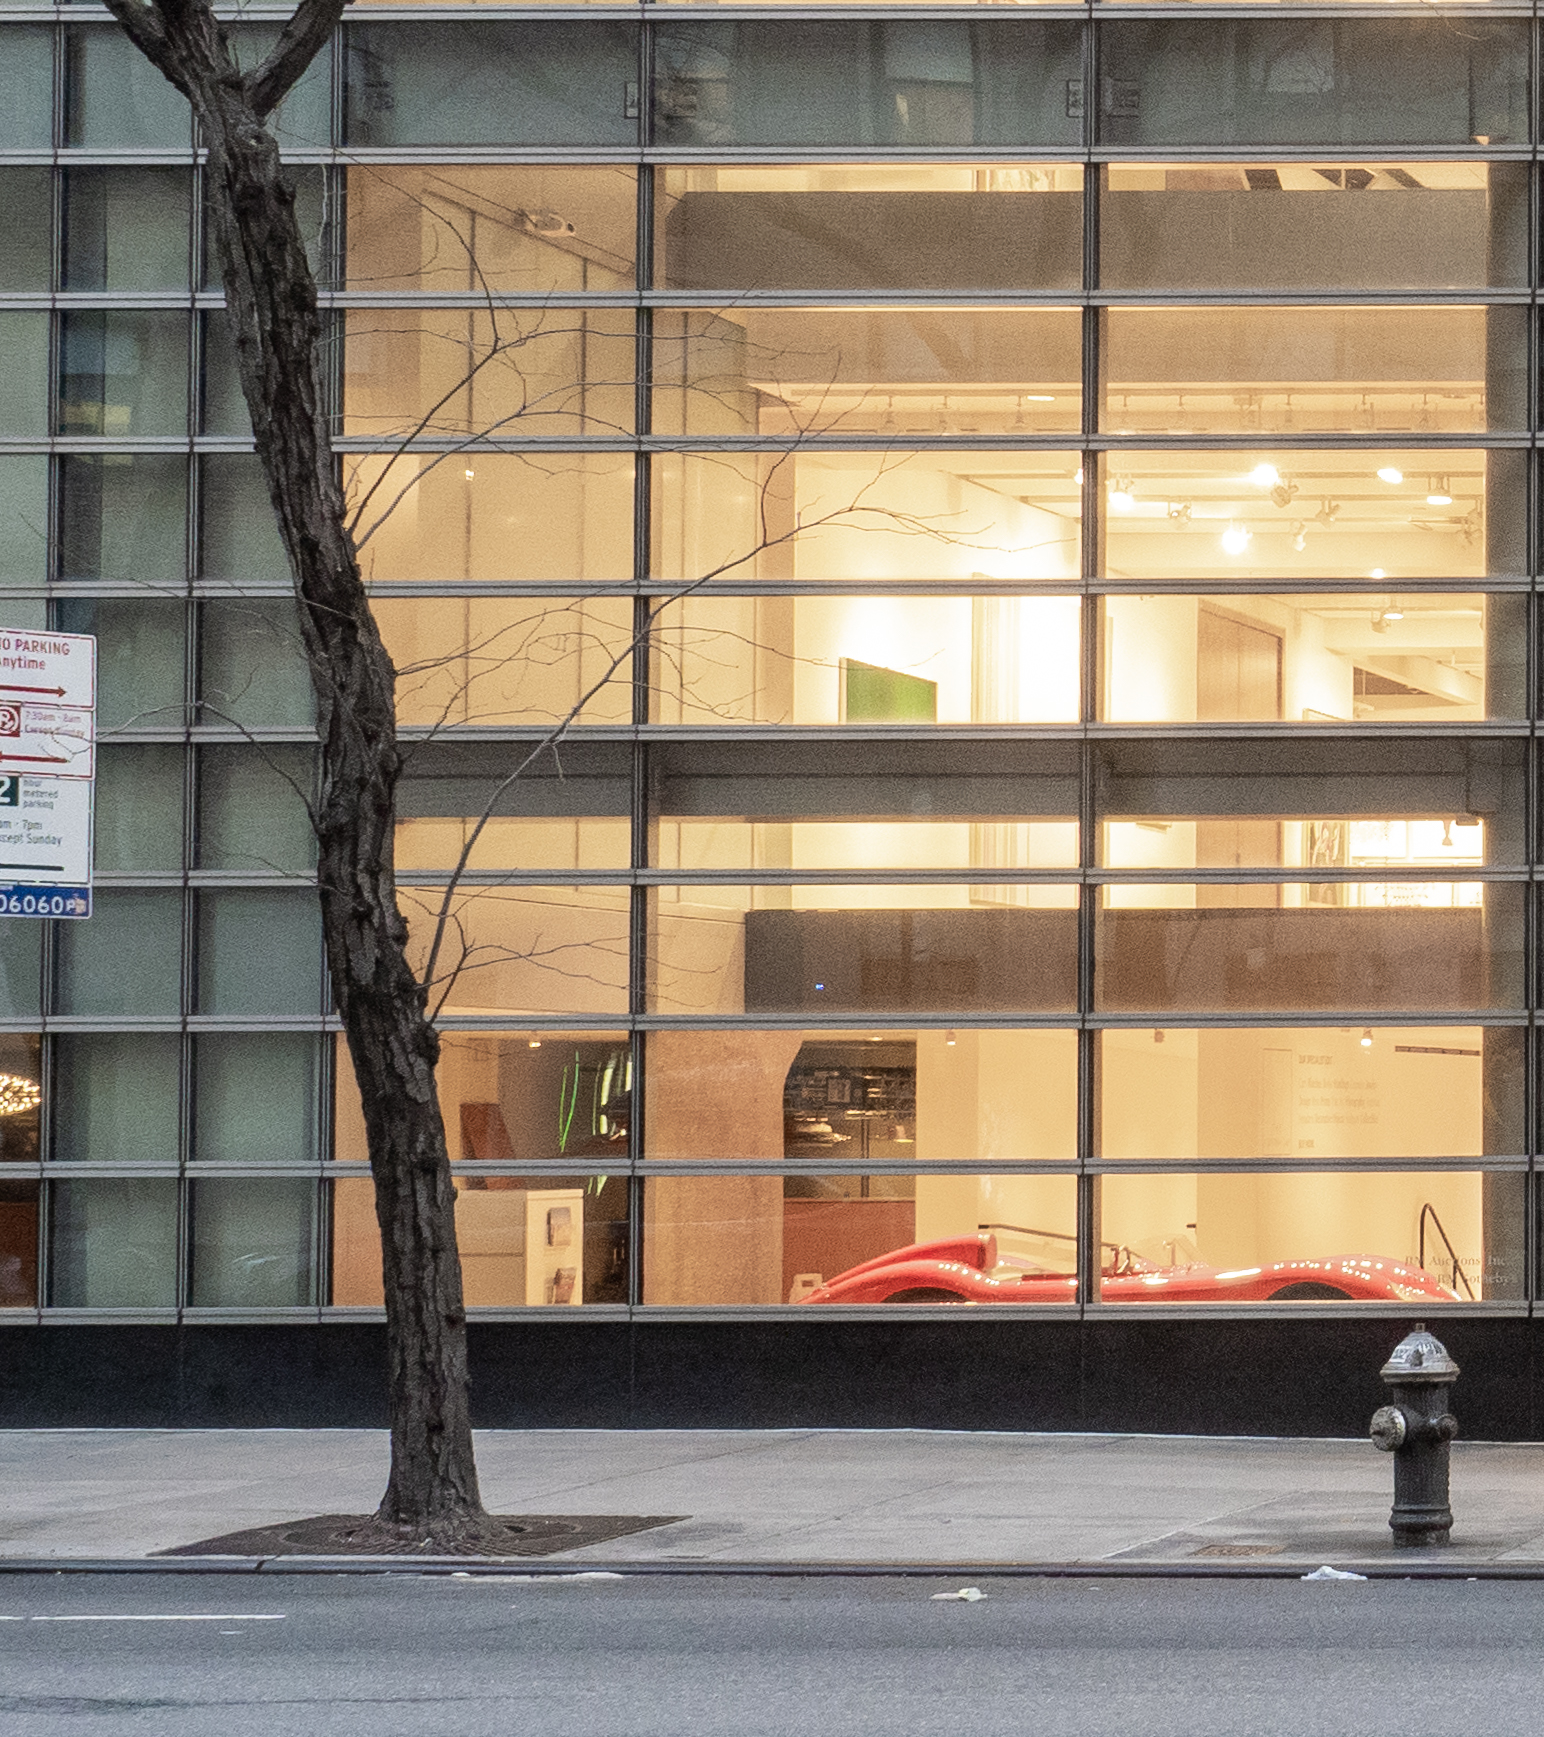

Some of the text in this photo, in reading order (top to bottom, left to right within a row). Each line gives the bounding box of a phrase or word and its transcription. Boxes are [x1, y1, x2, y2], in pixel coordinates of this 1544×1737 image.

[15, 638, 70, 656] PARKING
[0, 655, 46, 670] nytime
[27, 833, 63, 847] Sunday
